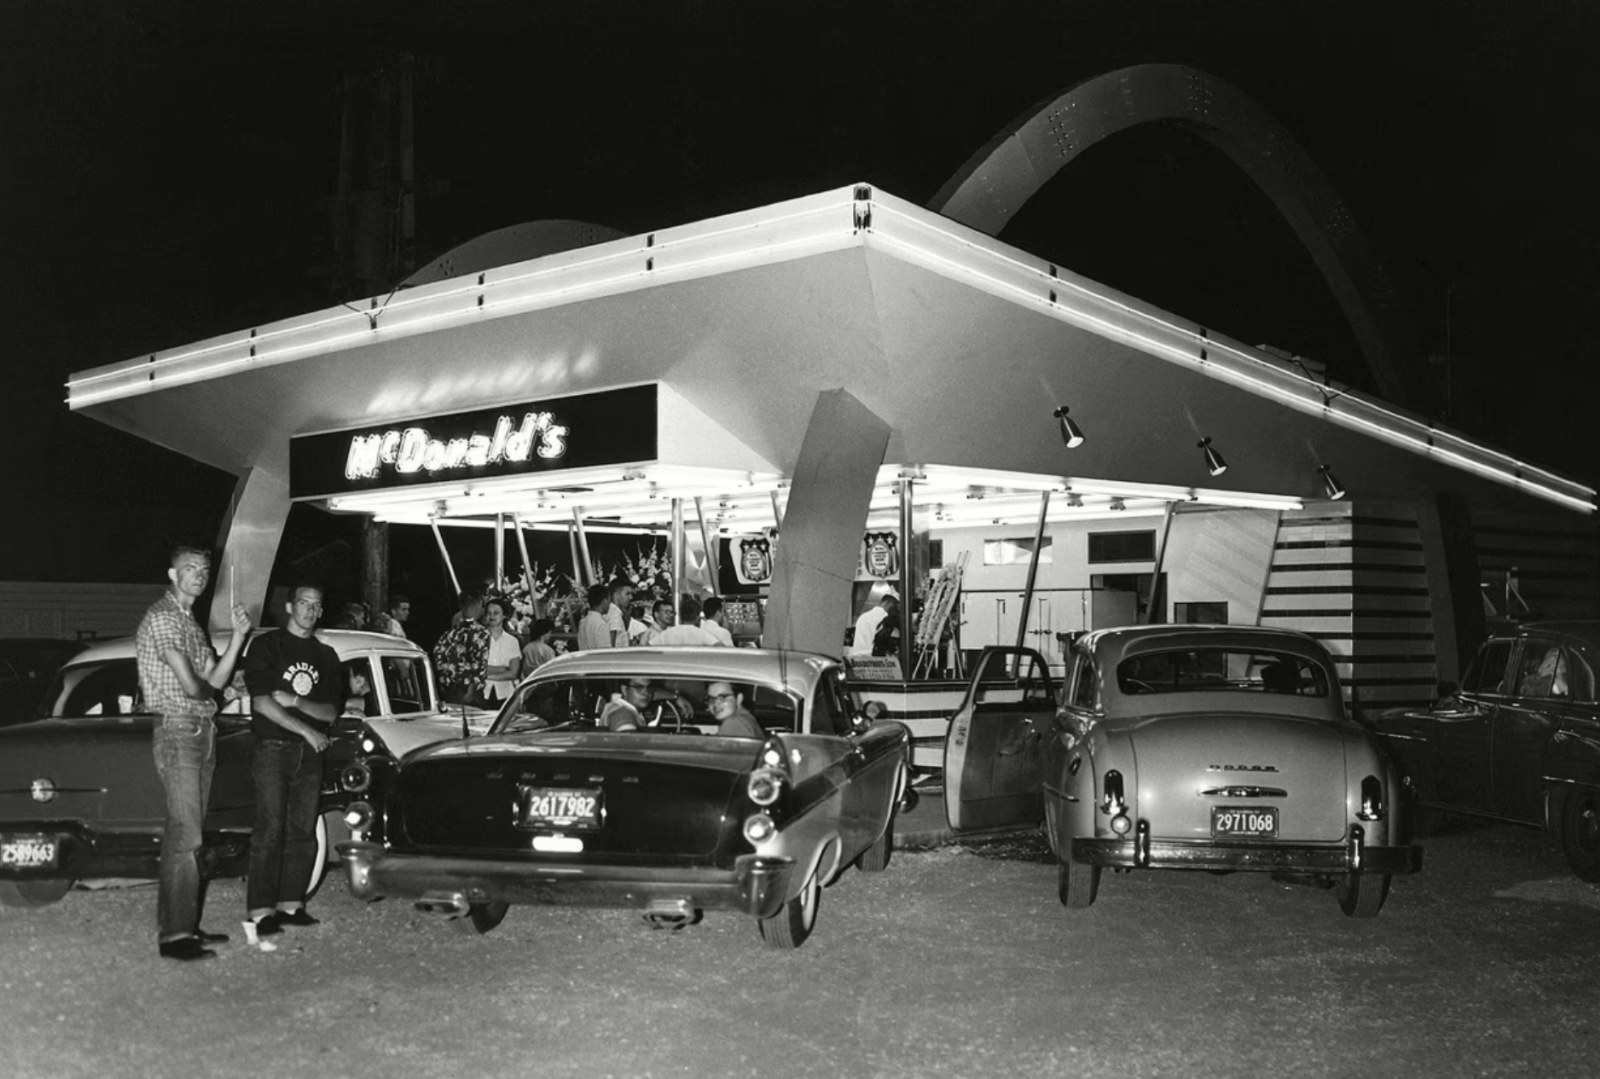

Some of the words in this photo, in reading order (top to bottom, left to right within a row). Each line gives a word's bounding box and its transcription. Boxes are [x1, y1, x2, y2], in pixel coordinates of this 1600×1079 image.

[345, 411, 570, 480] McDonald's
[530, 796, 596, 817] 2617982
[1217, 814, 1273, 831] 2971068
[2, 843, 54, 863] 2589663
